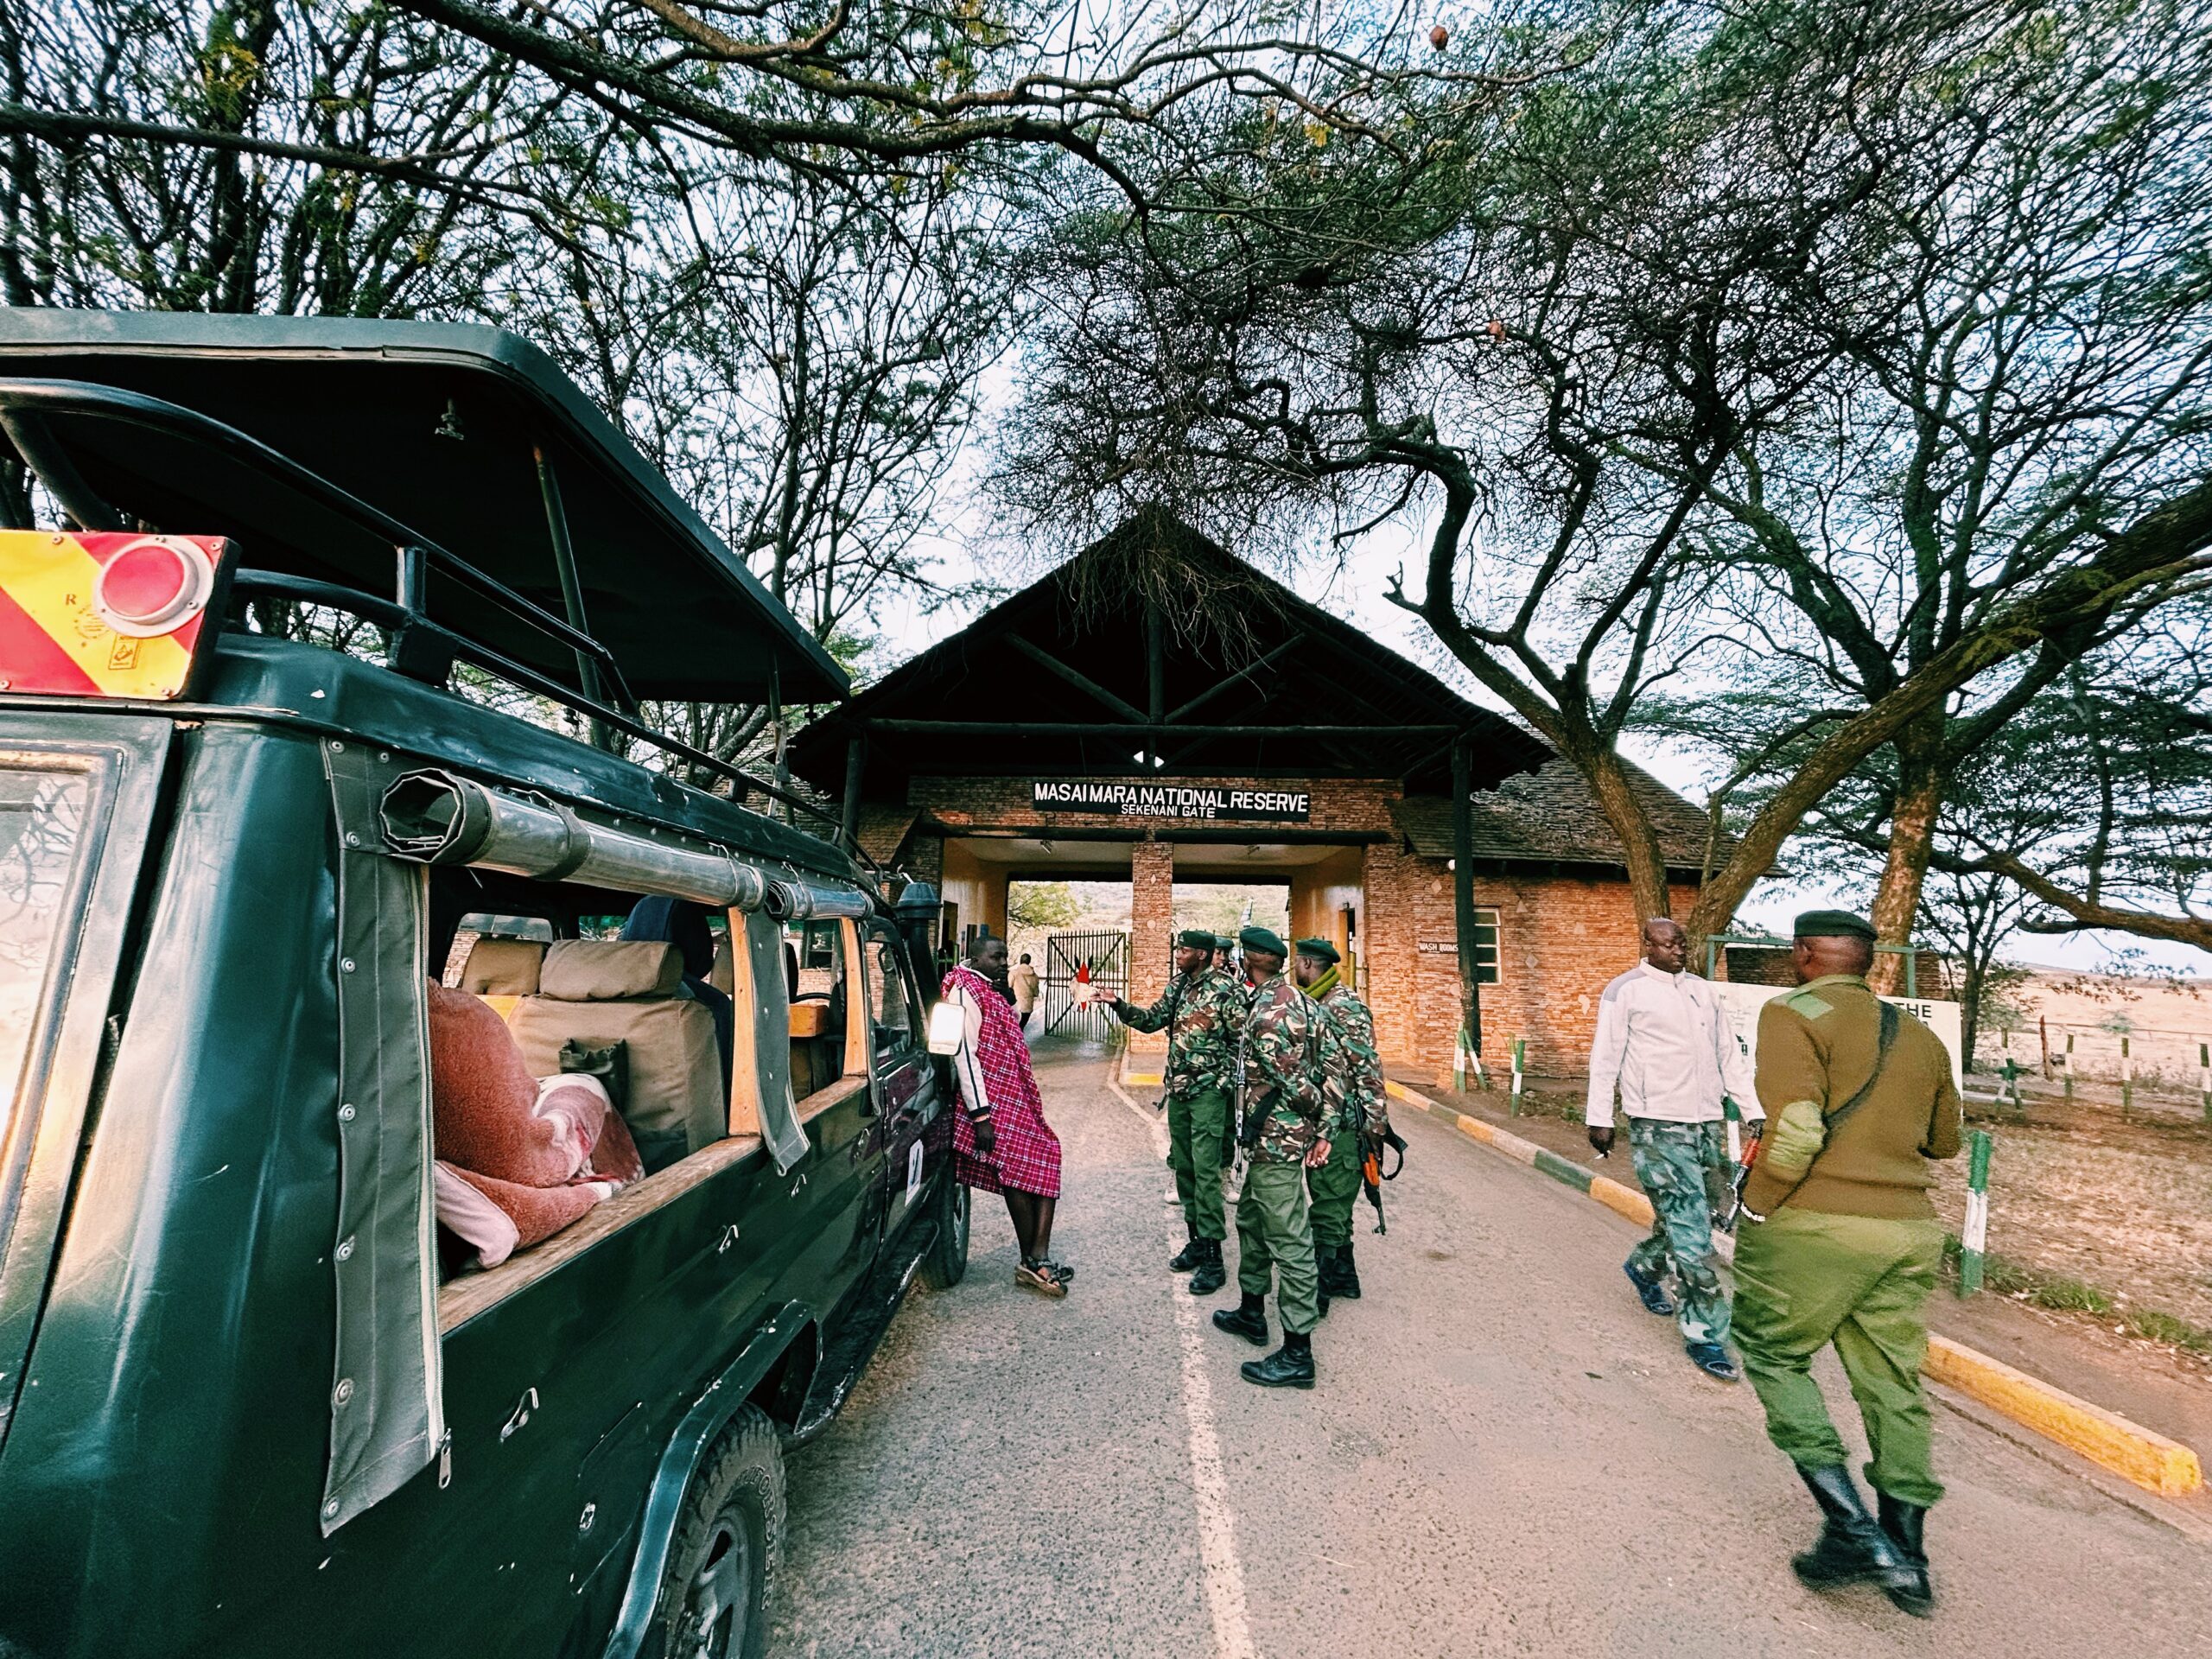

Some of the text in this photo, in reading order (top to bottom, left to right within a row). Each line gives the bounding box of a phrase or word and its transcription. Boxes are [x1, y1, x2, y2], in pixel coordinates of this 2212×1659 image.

[1034, 783, 1308, 812] MASAI MARA NATIONAL RESERVE
[1121, 804, 1217, 818] SEKENANI GATE
[1419, 943, 1459, 952] WASH ROOMS
